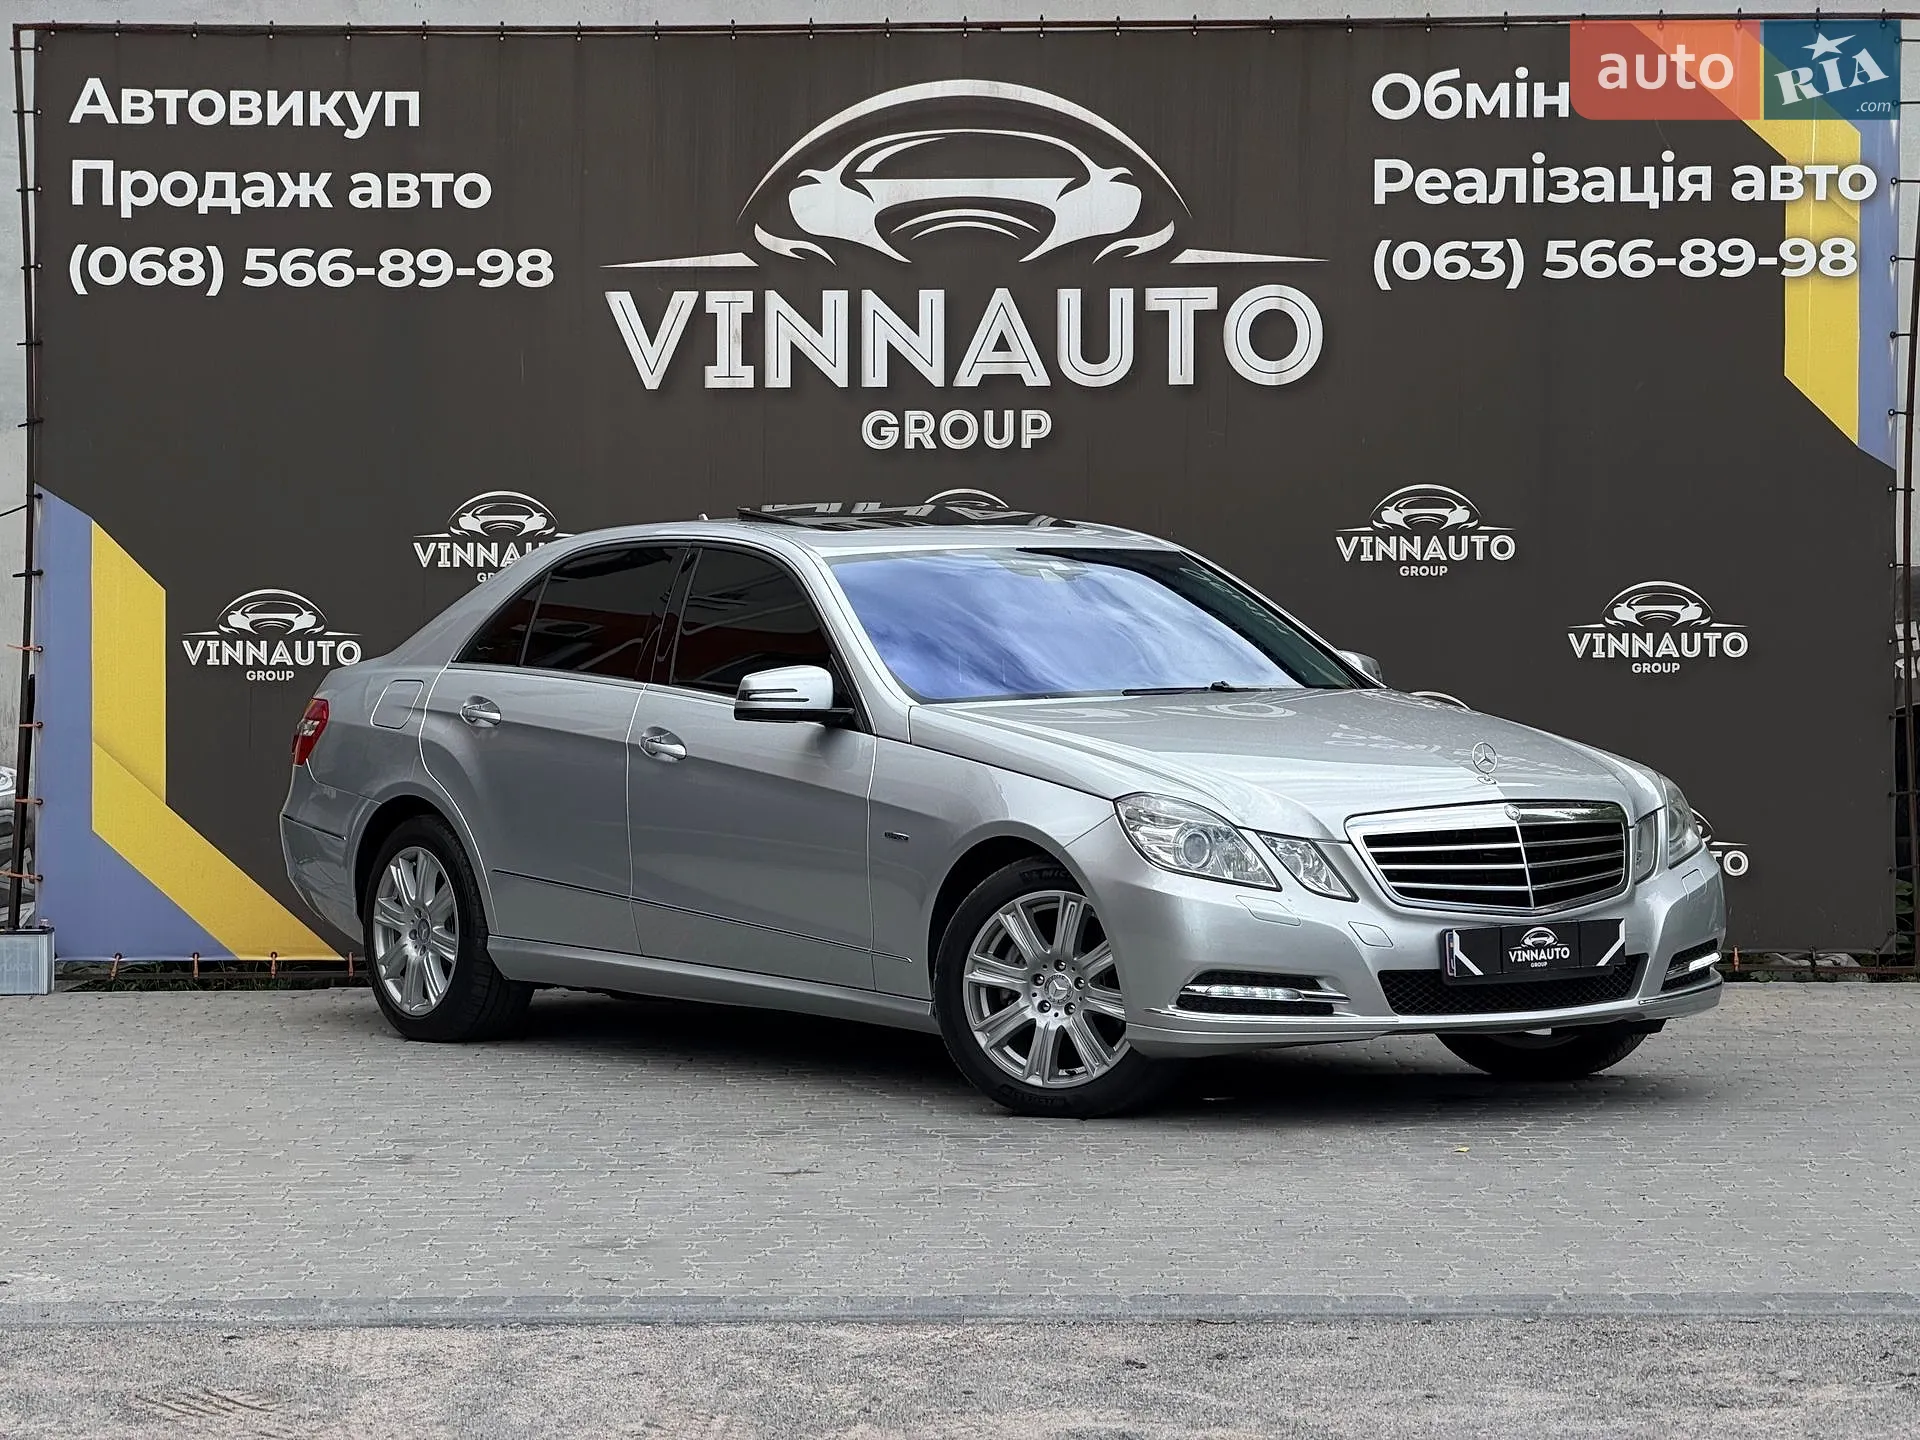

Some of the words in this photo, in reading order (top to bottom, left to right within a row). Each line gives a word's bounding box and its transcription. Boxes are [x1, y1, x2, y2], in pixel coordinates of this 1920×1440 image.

[69, 77, 420, 140] Автовикуп
[1371, 66, 1570, 121] Обмін
[71, 159, 334, 219] Продаж
[349, 172, 492, 209] авто
[1373, 150, 1712, 210] Реалізація
[1731, 164, 1878, 202] авто
[69, 243, 224, 297] (068)
[242, 247, 554, 288] 566-89-98
[1373, 238, 1525, 291] (063)
[1543, 237, 1858, 279] 566-89-98
[605, 284, 1324, 390] VINNAUTO
[861, 409, 1052, 450] GROUP
[413, 542, 544, 568] VINNA
[1336, 534, 1516, 562] VINNAUTO
[1399, 565, 1448, 577] GROUP
[182, 640, 362, 666] VINNAUTO
[1568, 631, 1749, 659] VINNAUTO
[246, 670, 295, 681] GROUP
[1631, 662, 1681, 674] GROUP
[1508, 946, 1570, 963] VINNAUTO
